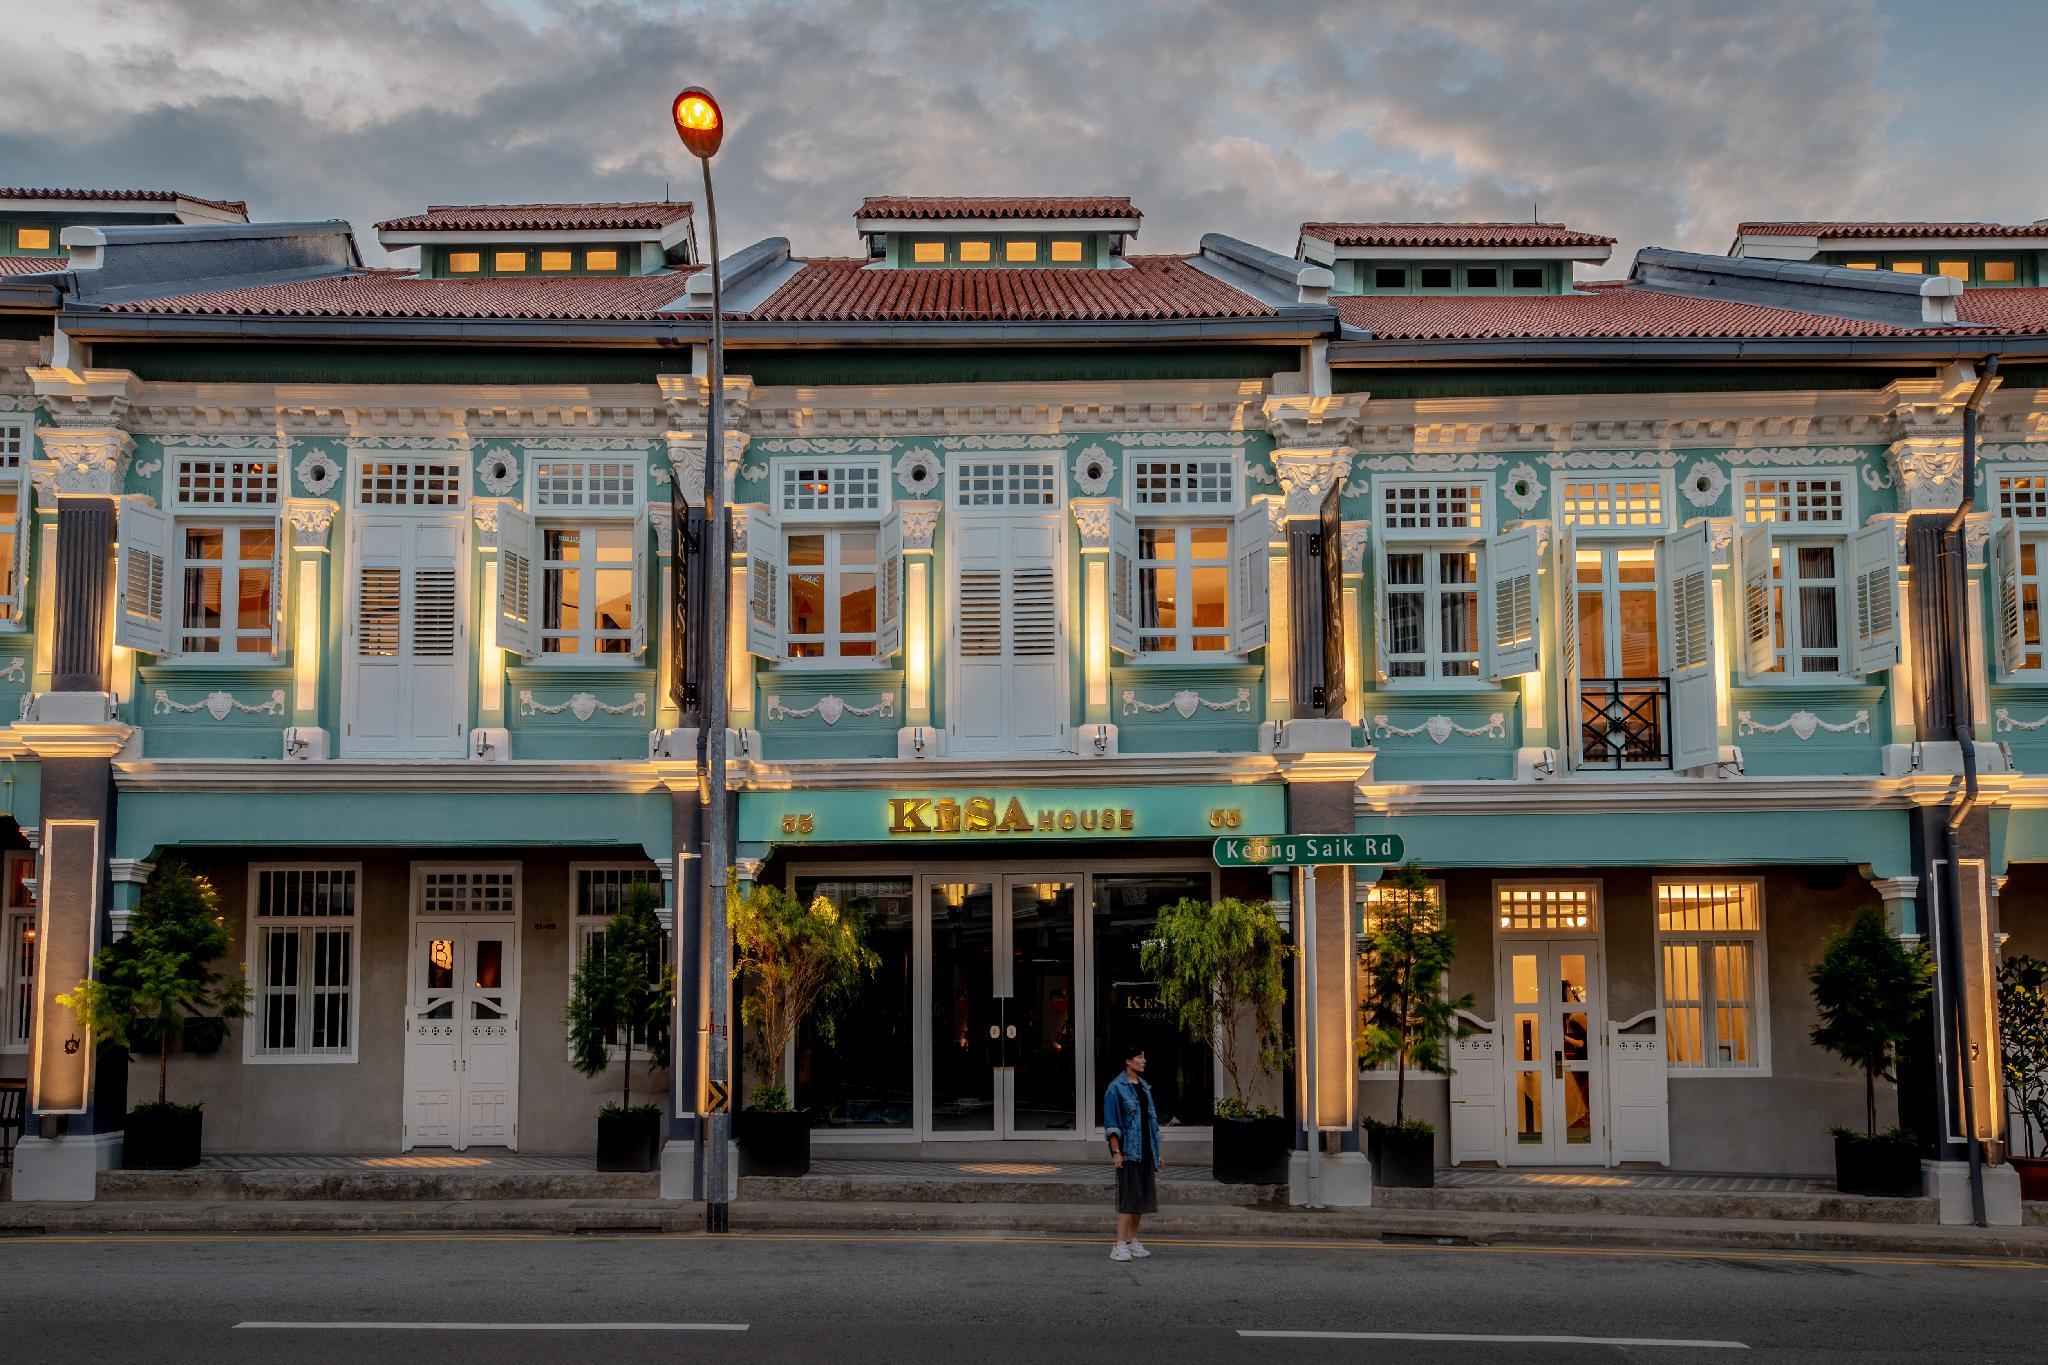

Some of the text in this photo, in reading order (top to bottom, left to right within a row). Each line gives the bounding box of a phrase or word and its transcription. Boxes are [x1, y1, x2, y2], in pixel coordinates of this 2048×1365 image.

[782, 813, 815, 834] 55
[1037, 808, 1134, 831] HOUSE
[1209, 808, 1241, 828] 55
[1226, 837, 1393, 862] Keong Saik Rd
